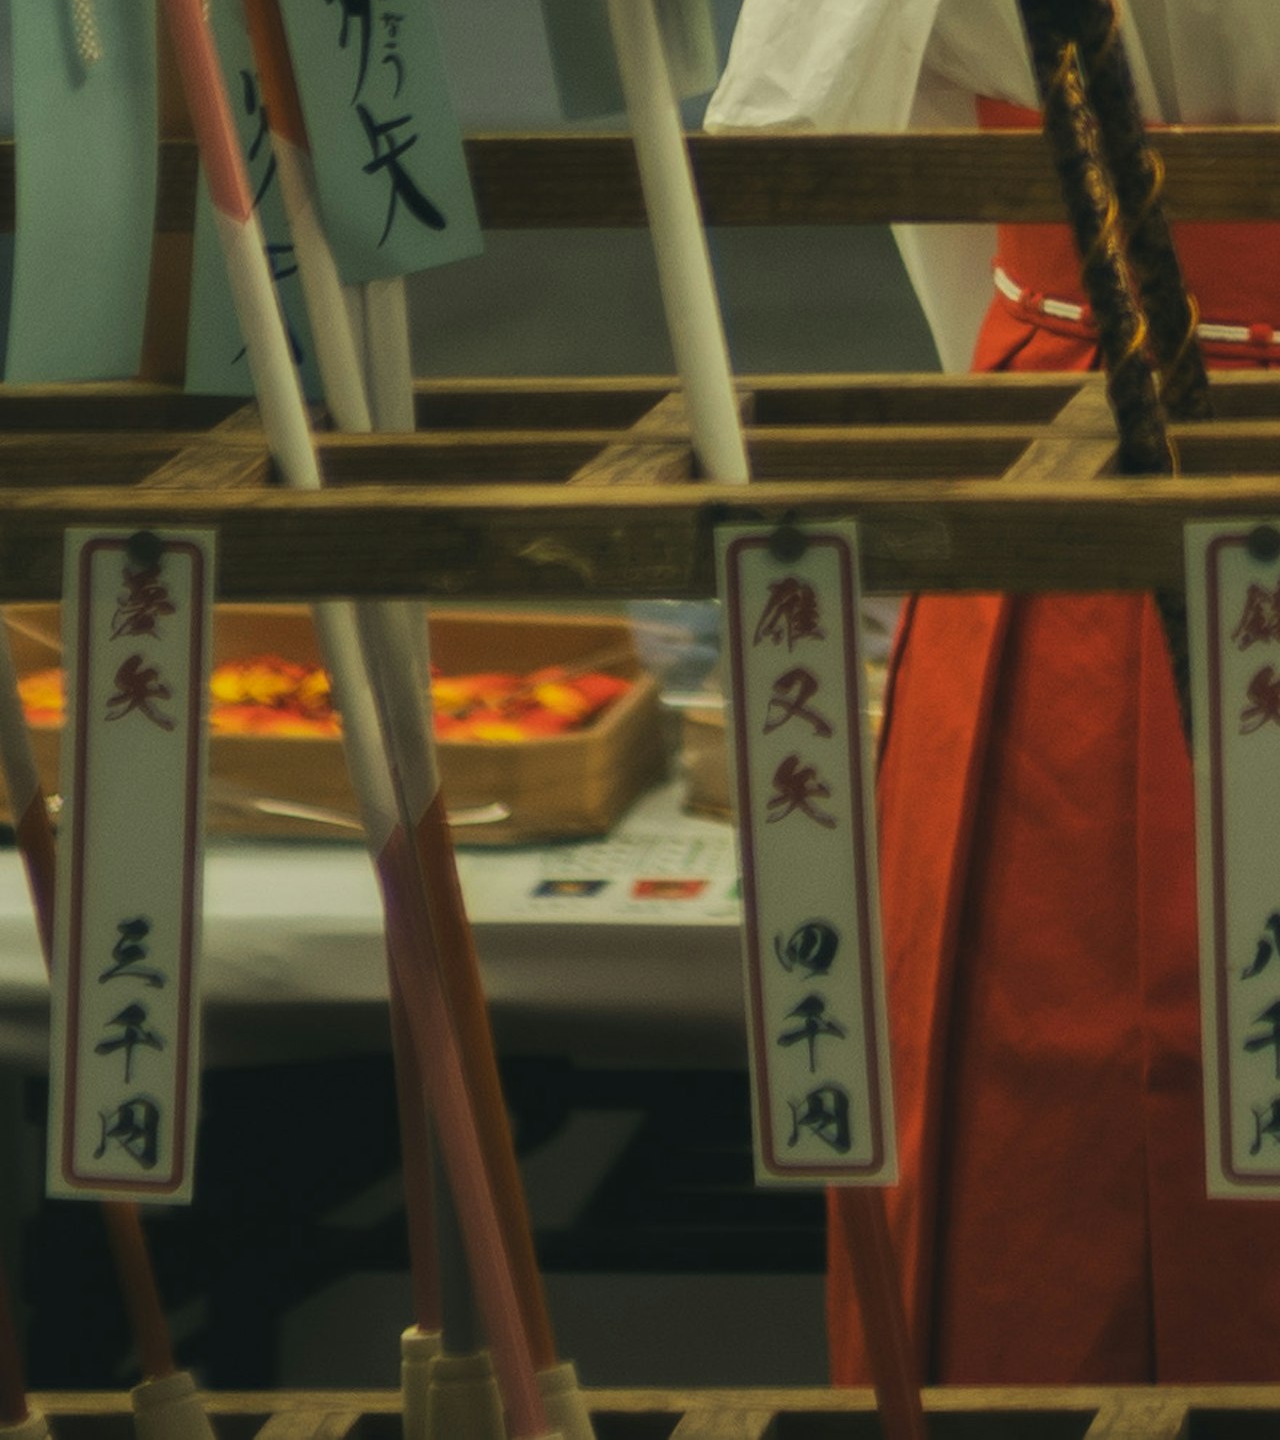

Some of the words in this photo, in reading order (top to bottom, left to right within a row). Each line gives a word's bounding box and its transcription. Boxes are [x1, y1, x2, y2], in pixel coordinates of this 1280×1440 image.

[93, 918, 166, 1171] 三千円
[773, 918, 854, 1155] 四千円
